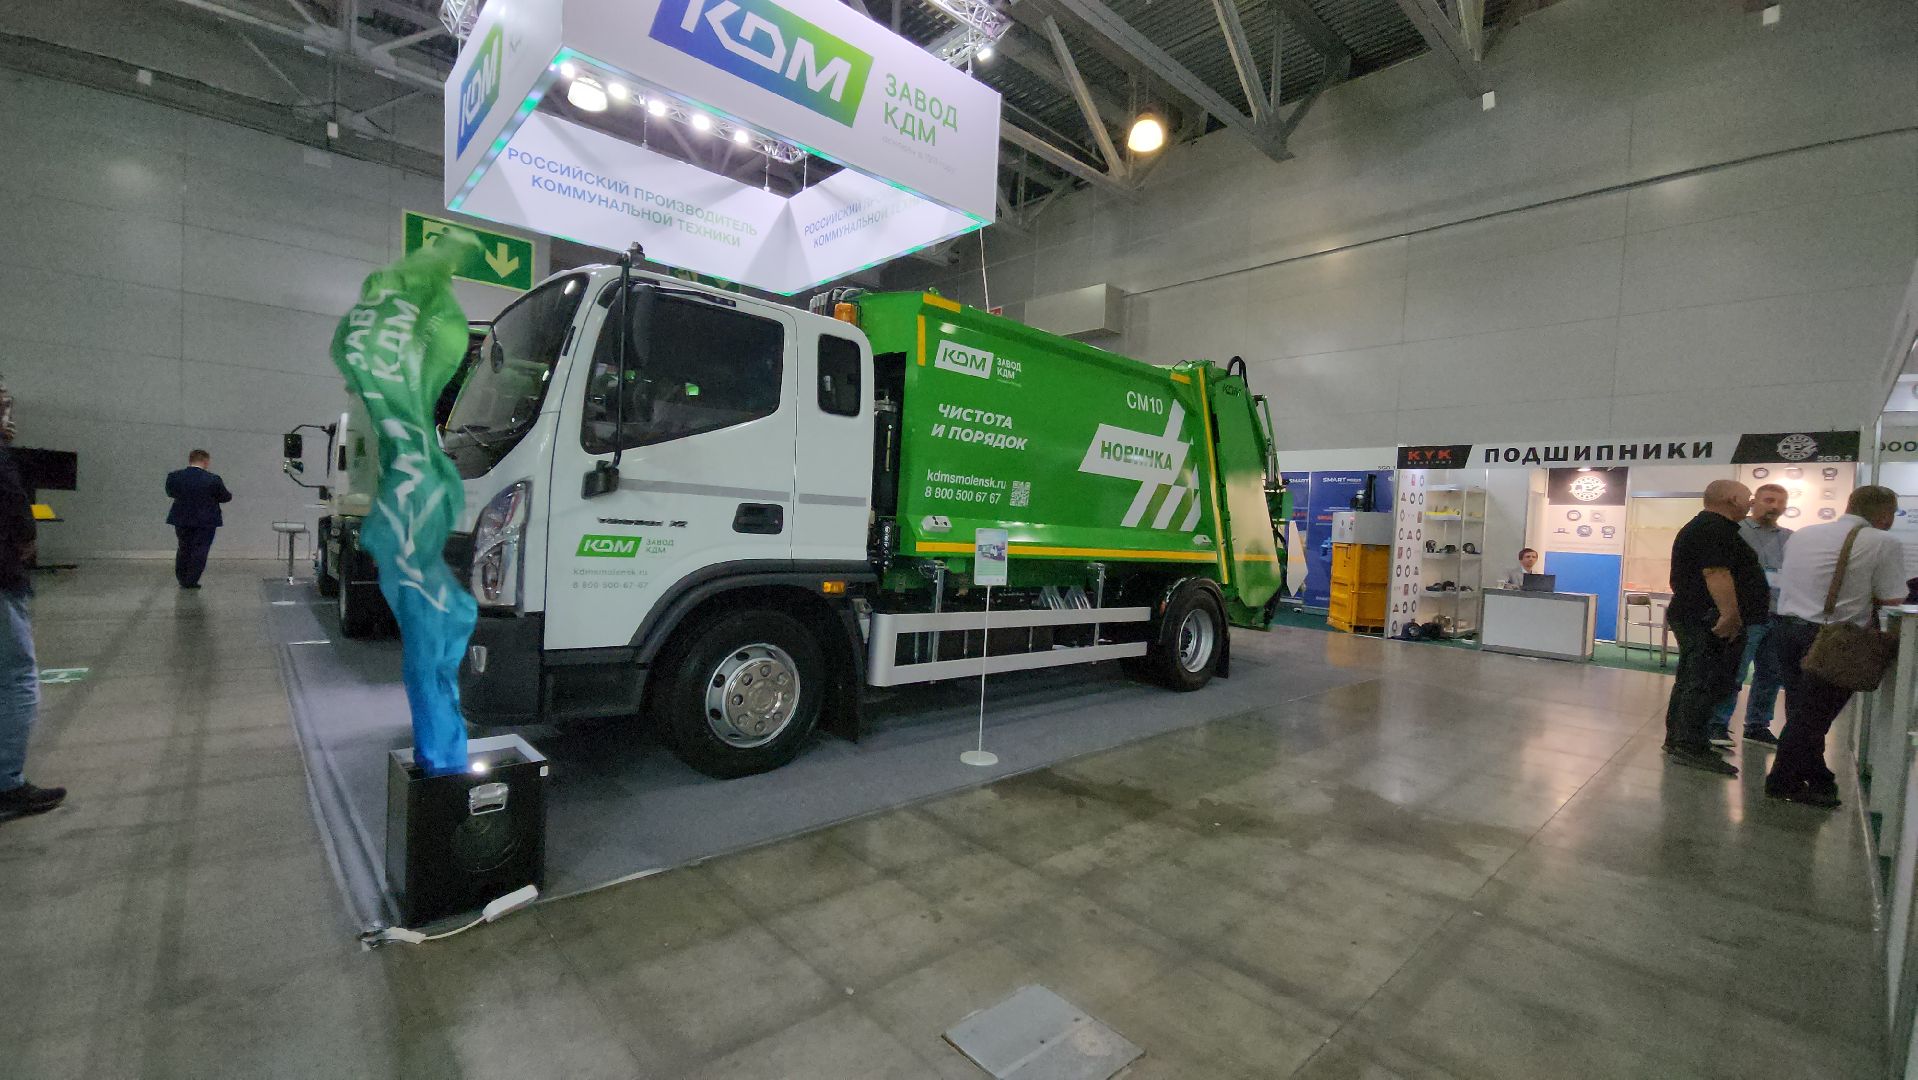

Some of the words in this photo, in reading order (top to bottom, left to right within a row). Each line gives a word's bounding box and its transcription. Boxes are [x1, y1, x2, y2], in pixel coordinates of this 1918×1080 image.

[681, 0, 852, 102] KDM
[885, 73, 958, 132] ЗАВОД
[884, 102, 937, 146] КДМ
[508, 148, 629, 196] РОССИЙСКИЙ
[634, 188, 758, 237] ПРОИЗВОДИТЕЛЬ
[531, 175, 673, 226] КОММУНАЛЬНОЙ
[677, 218, 741, 248] ТЕХНИКИ
[943, 347, 987, 372] KDM
[997, 357, 1022, 373] ЗАВОД
[997, 367, 1016, 379] КДМ
[938, 403, 1013, 429] ЧИСТОТА
[931, 423, 946, 438] И
[949, 425, 1028, 451] ПОРЯДОК
[1100, 440, 1173, 471] НОВИНКА
[1484, 442, 1713, 465] ПОДШИПНИКИ
[927, 469, 1006, 490] kdmsmolensk.ru
[924, 486, 933, 498] 8
[934, 487, 953, 500] 800
[956, 489, 974, 502] 500
[975, 491, 988, 503] 67
[989, 493, 1001, 505] 67
[583, 539, 636, 553] KDM
[646, 539, 675, 547] ЗАВОД
